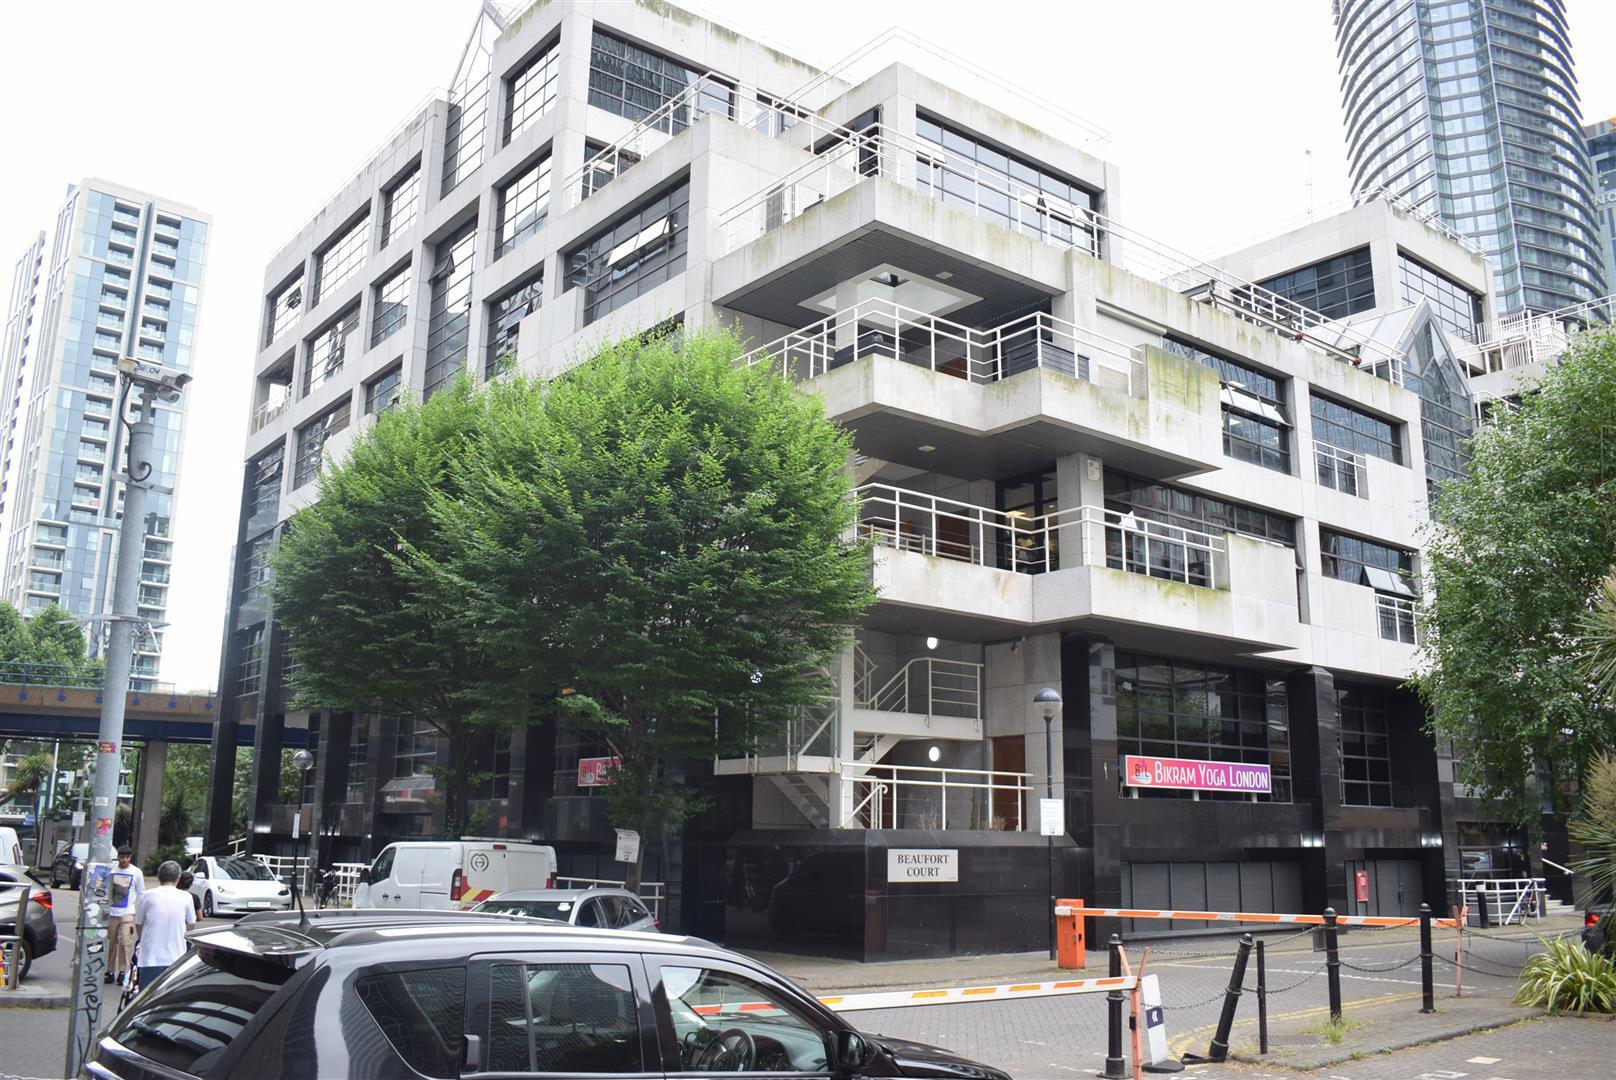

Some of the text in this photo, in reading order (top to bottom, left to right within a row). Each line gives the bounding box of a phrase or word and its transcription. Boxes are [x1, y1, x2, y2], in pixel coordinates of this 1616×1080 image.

[1199, 764, 1226, 786] YOGA
[1229, 765, 1268, 788] LONDON
[897, 854, 949, 864] BEAUFORT
[906, 867, 940, 877] COURT
